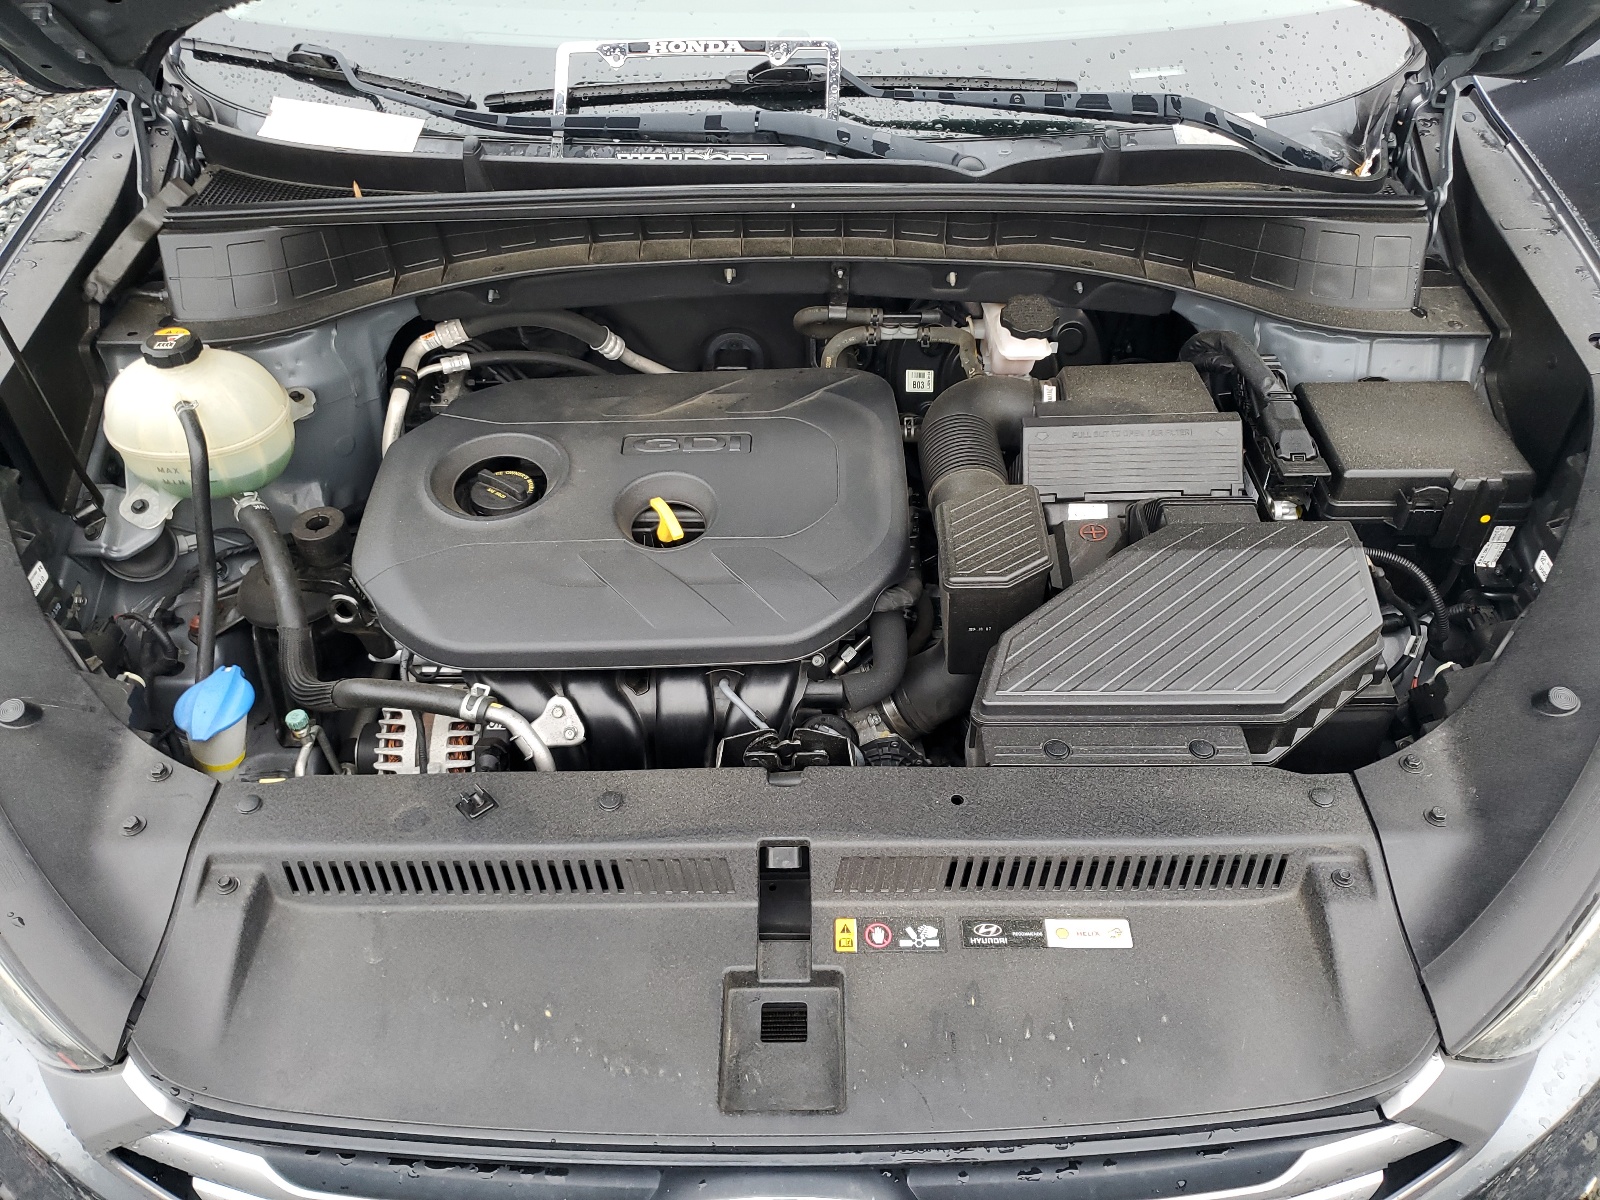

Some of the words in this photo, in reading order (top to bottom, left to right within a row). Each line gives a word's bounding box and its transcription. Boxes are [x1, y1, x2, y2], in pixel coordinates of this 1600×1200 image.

[648, 40, 745, 53] HONDA
[912, 381, 925, 389] B03
[157, 466, 180, 475] MAX
[970, 937, 1008, 945] HYUNDAI
